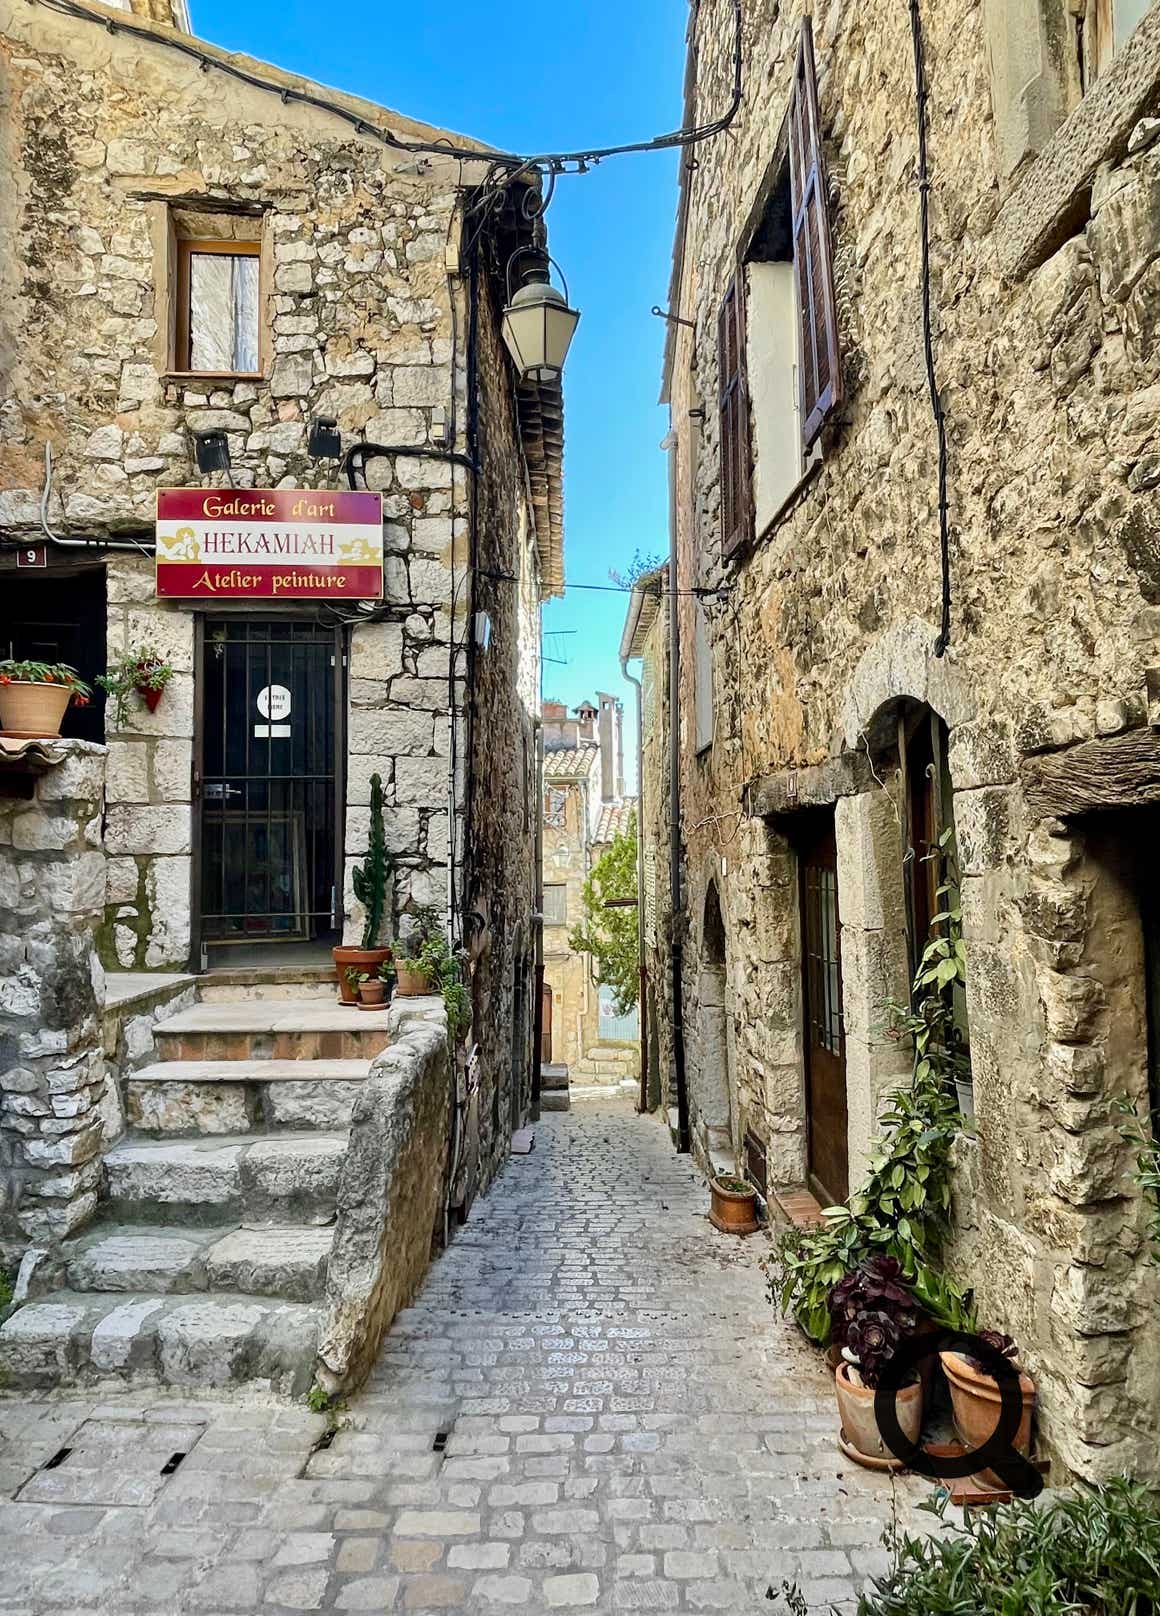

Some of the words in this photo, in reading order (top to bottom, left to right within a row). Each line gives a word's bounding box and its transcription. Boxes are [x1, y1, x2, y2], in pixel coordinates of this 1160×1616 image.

[203, 496, 276, 517] Galerie
[292, 499, 335, 517] d'art
[203, 532, 335, 555] HEKAMIAH
[27, 550, 36, 562] 9
[192, 570, 262, 591] Atelier
[271, 571, 346, 594] peinture
